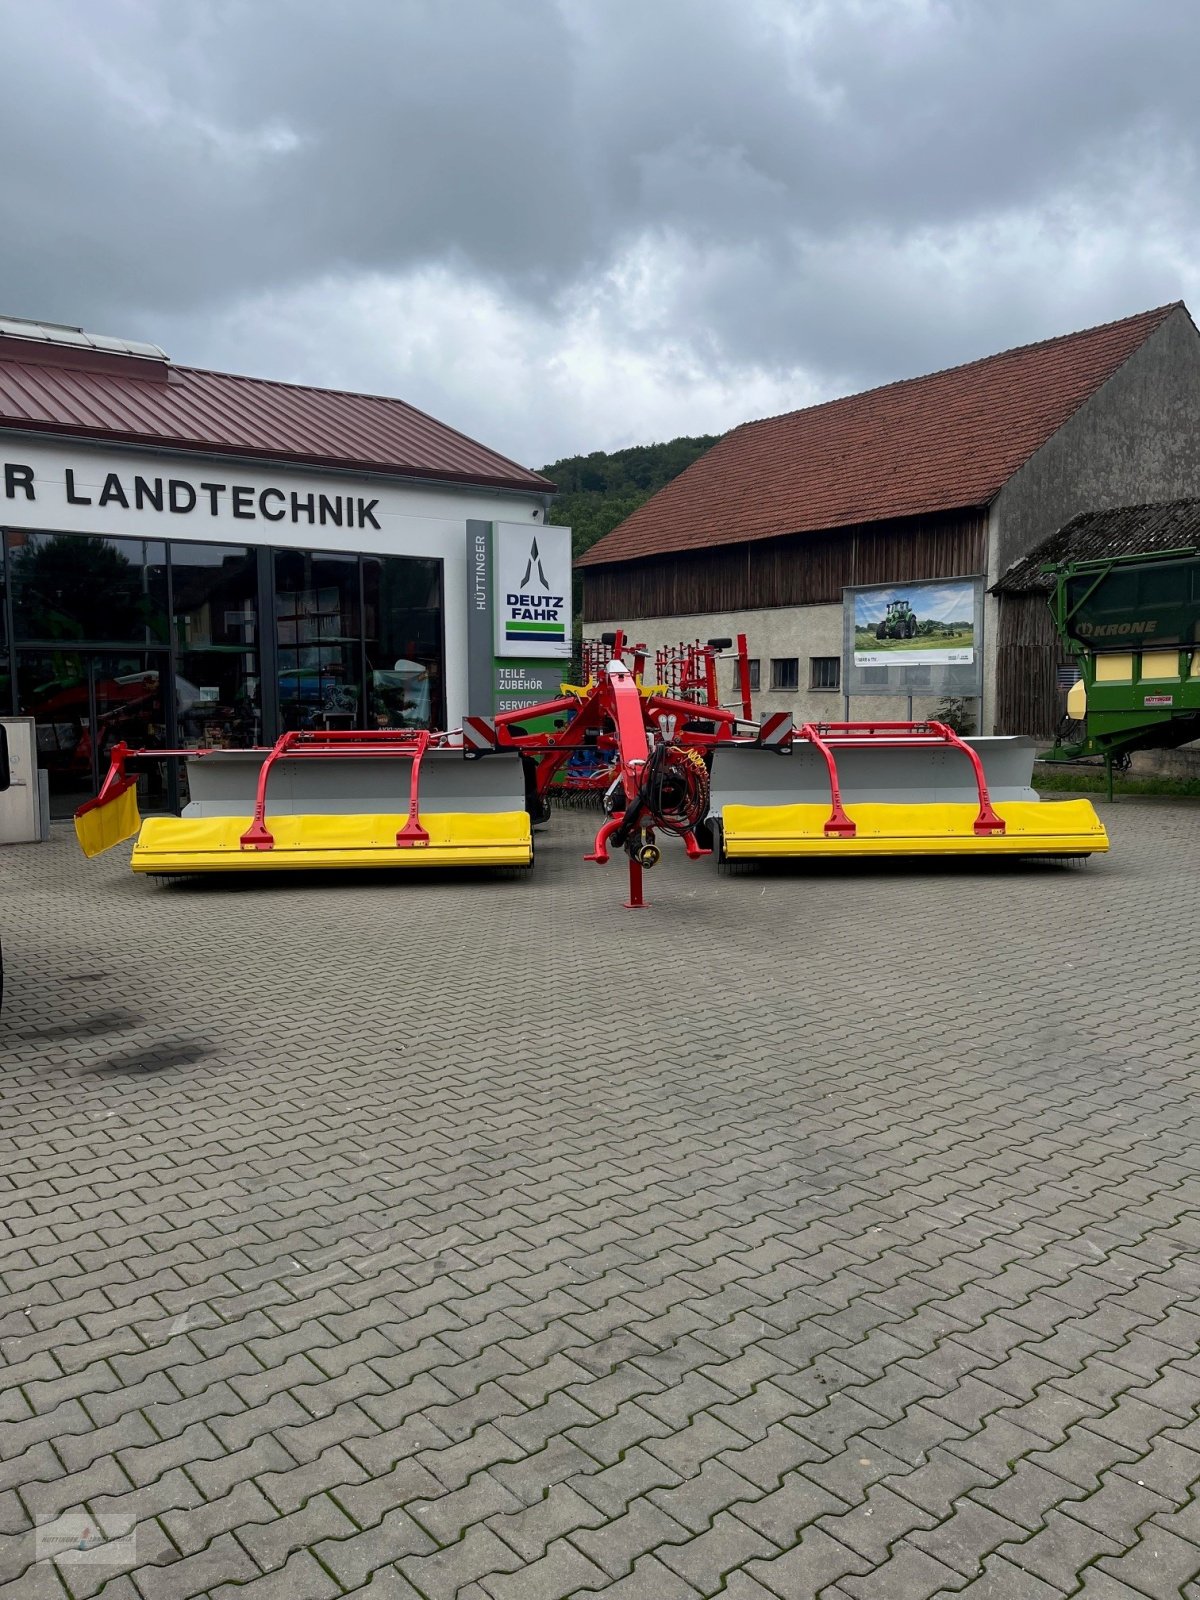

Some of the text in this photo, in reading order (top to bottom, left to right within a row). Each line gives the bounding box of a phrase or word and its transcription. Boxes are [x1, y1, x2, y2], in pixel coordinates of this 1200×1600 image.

[65, 468, 382, 530] LANDTECHNIK
[474, 535, 486, 610] HÜTTINGER
[506, 593, 564, 608] DEUTZ
[511, 607, 559, 621] FAHR
[1094, 620, 1158, 637] KRONE
[499, 668, 526, 679] TEILE
[499, 677, 543, 690] ZUBEHÖR
